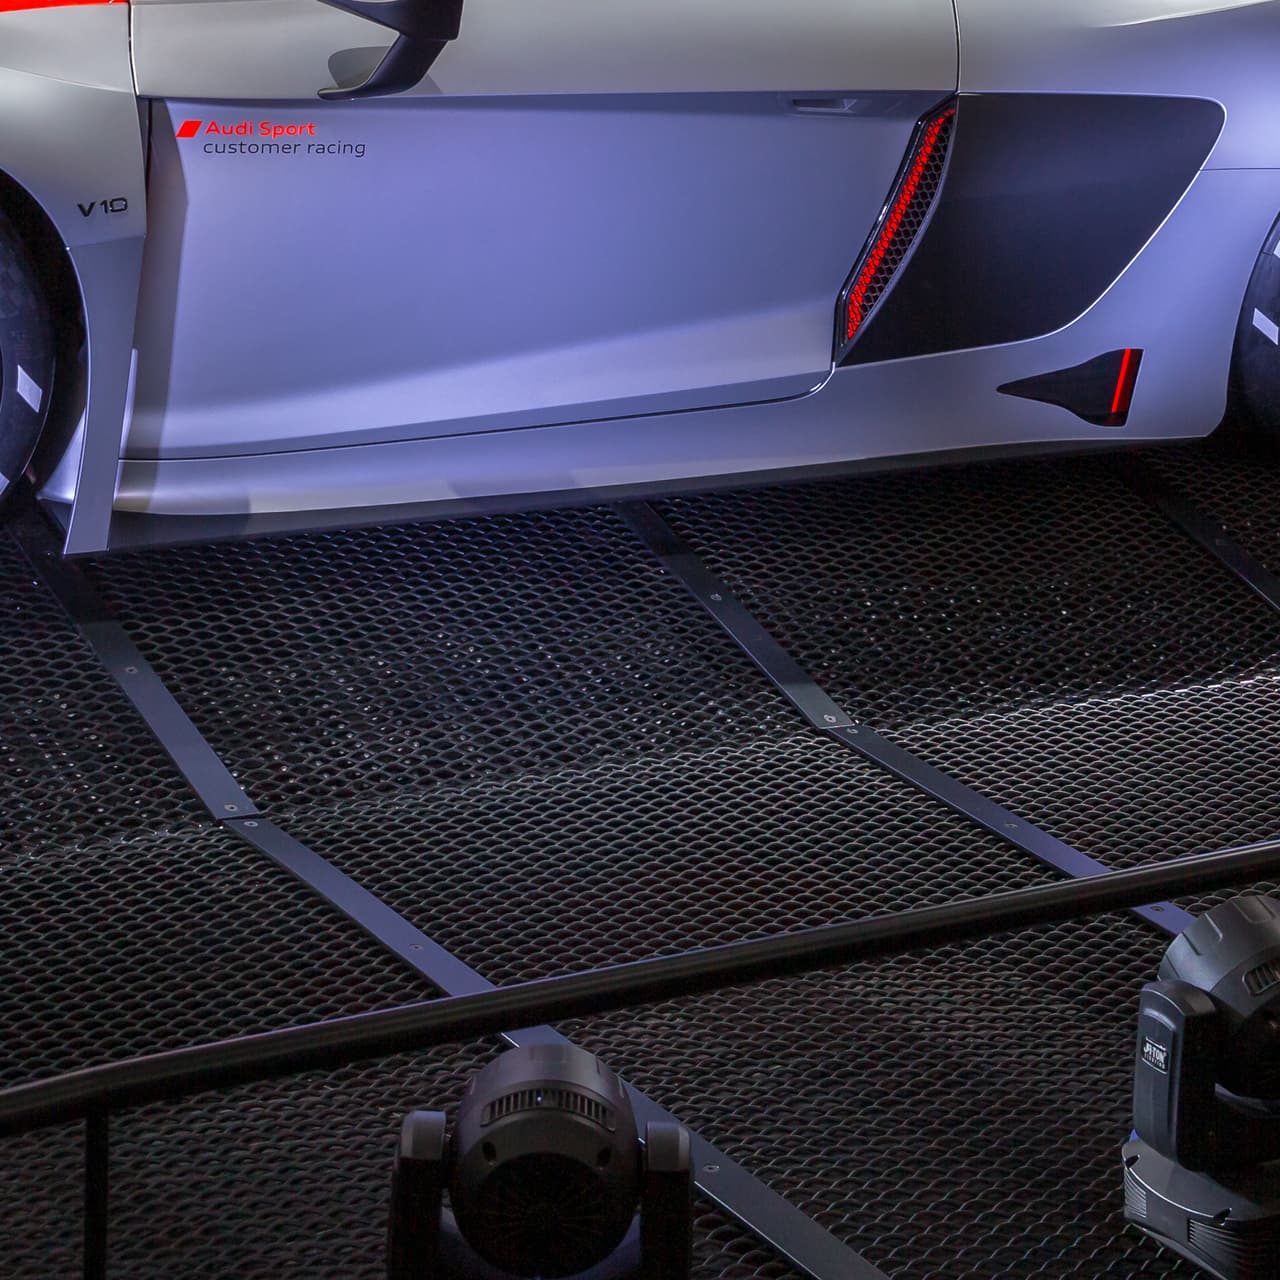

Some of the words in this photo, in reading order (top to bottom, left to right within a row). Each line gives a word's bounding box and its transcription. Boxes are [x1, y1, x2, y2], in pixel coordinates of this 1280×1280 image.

[205, 121, 253, 136] Audi
[259, 121, 317, 140] Sport
[203, 140, 302, 155] customer
[307, 140, 367, 158] racing
[77, 197, 128, 217] V10
